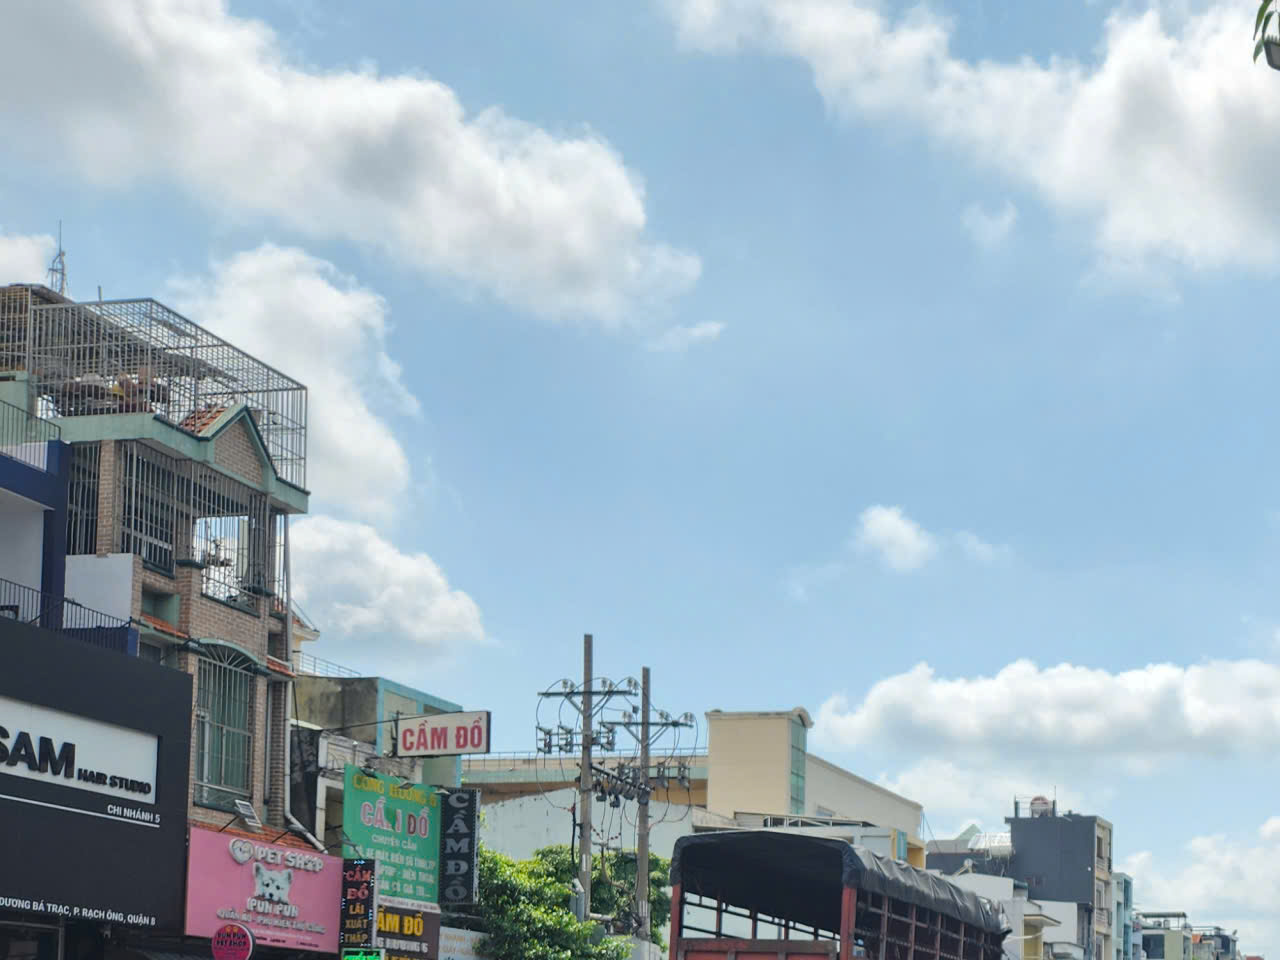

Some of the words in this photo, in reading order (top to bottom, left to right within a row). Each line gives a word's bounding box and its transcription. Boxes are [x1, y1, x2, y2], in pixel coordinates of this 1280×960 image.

[402, 720, 448, 752] CẦM
[456, 717, 483, 749] ĐỒ
[77, 768, 108, 787] HAIR
[109, 775, 152, 795] STUDIO
[107, 804, 122, 816] CHI
[123, 805, 153, 822] NHÁNH
[155, 815, 161, 823] 5
[254, 845, 284, 865] PET
[285, 851, 324, 873] SHOP
[32, 899, 45, 912] BÁ
[82, 908, 105, 921] RẠCH
[127, 912, 150, 926] QUẬN
[150, 917, 156, 926] 8
[376, 904, 400, 933] ẦM
